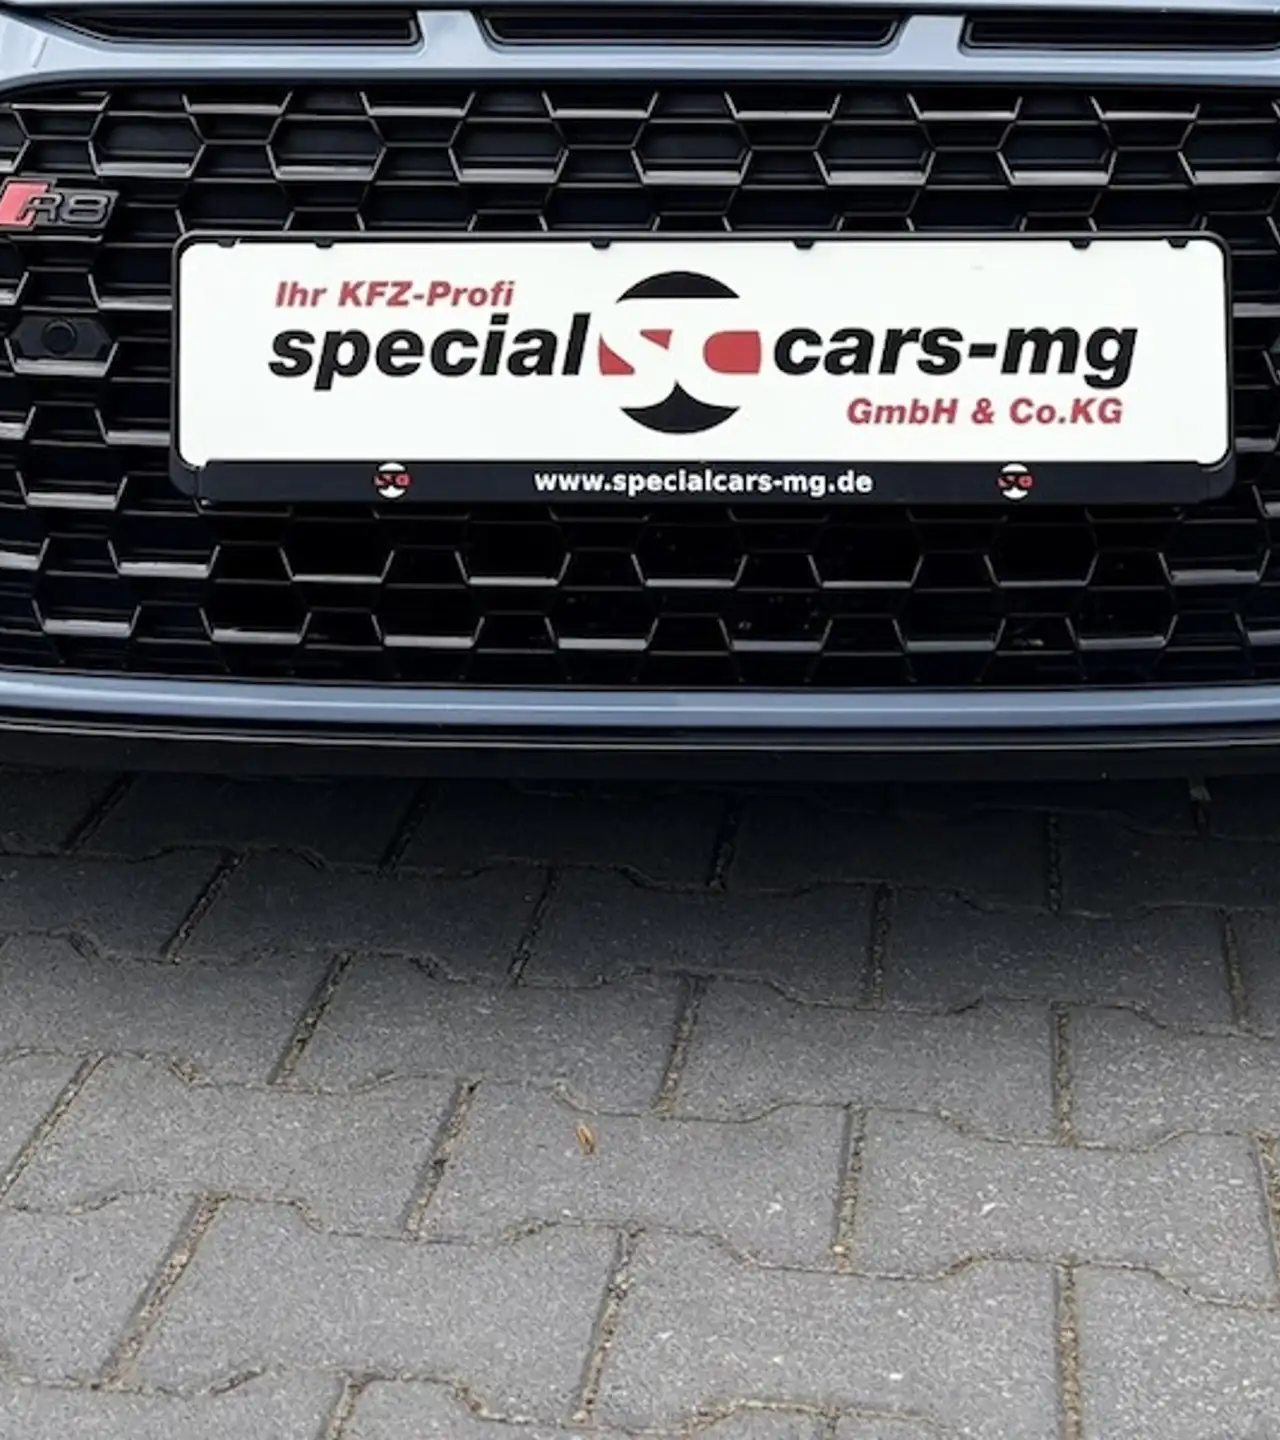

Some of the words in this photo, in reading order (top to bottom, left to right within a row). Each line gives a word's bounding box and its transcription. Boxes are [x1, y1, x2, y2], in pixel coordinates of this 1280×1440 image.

[275, 280, 327, 308] Ihr
[338, 279, 515, 308] KFZ-Profi
[268, 312, 591, 391] special
[773, 327, 1139, 391] cars-mg
[846, 397, 959, 426] GmbH
[970, 398, 995, 426] &
[1007, 397, 1123, 426] Co.KG
[533, 467, 874, 499] www.specialcars-mg.de
